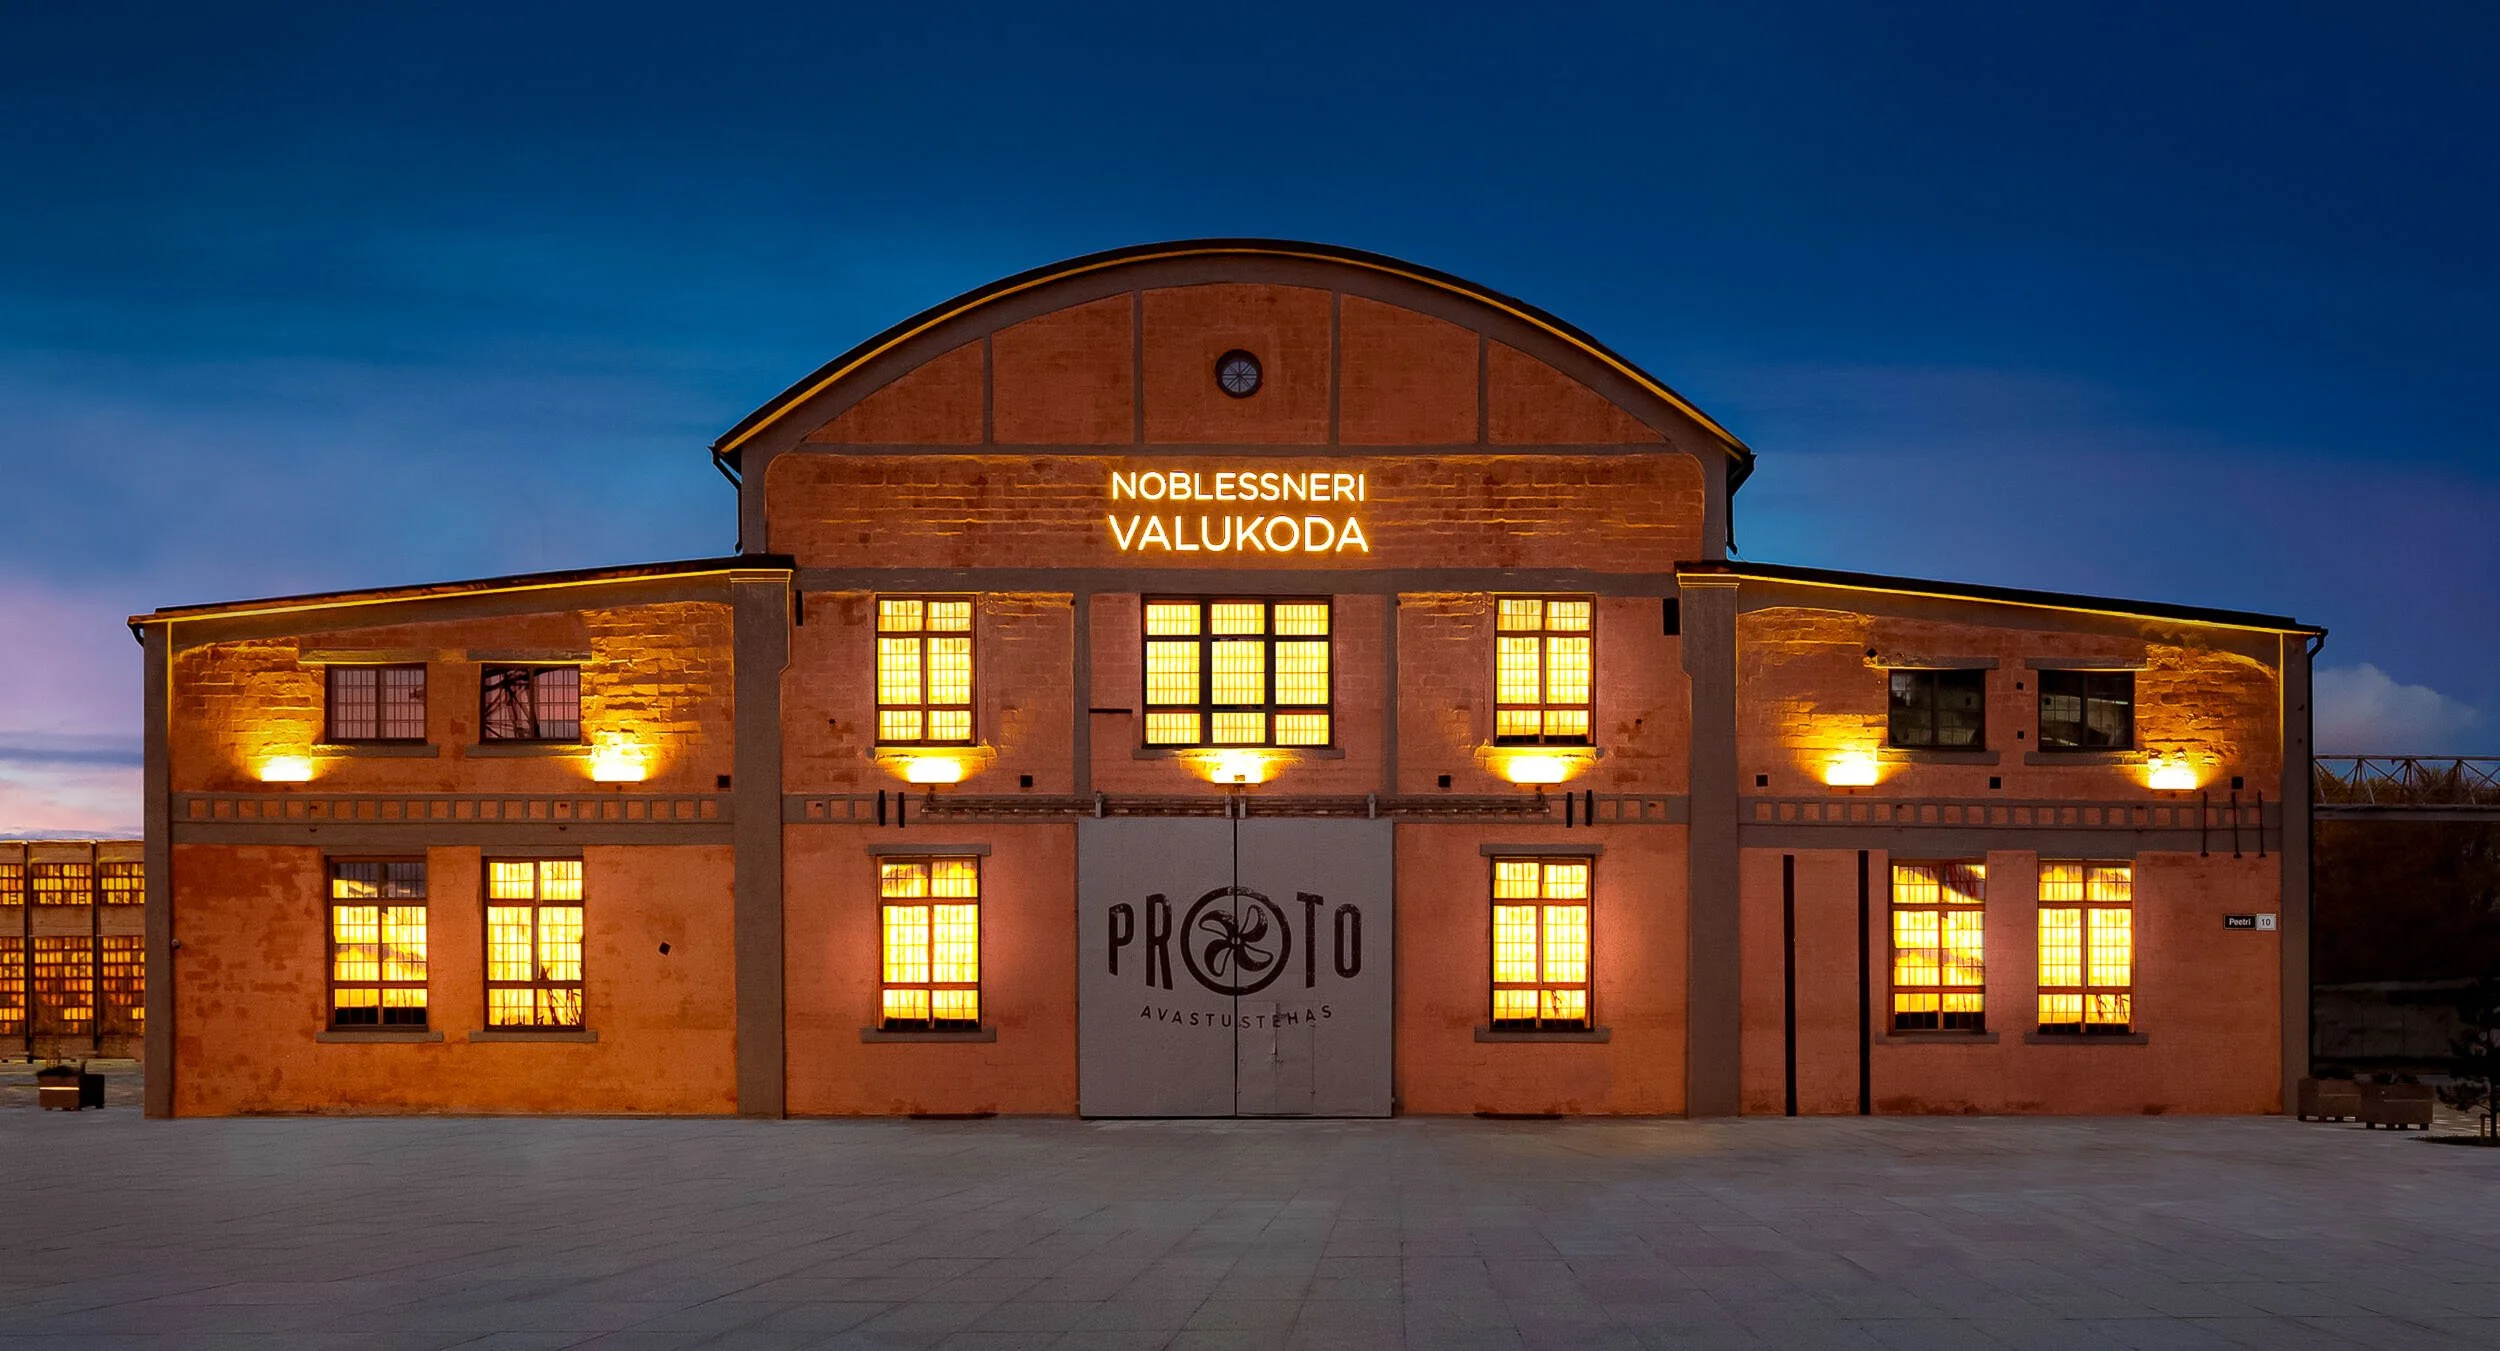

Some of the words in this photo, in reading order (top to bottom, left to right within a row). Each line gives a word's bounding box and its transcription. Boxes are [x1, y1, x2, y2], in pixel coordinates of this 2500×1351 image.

[1112, 471, 1365, 501] NOBLESSNERI
[1108, 515, 1369, 552] VALUKODA
[2261, 918, 2271, 926] 10
[1108, 886, 1361, 996] PROTO
[1141, 1005, 1332, 1028] AVASTUSTEHAS
